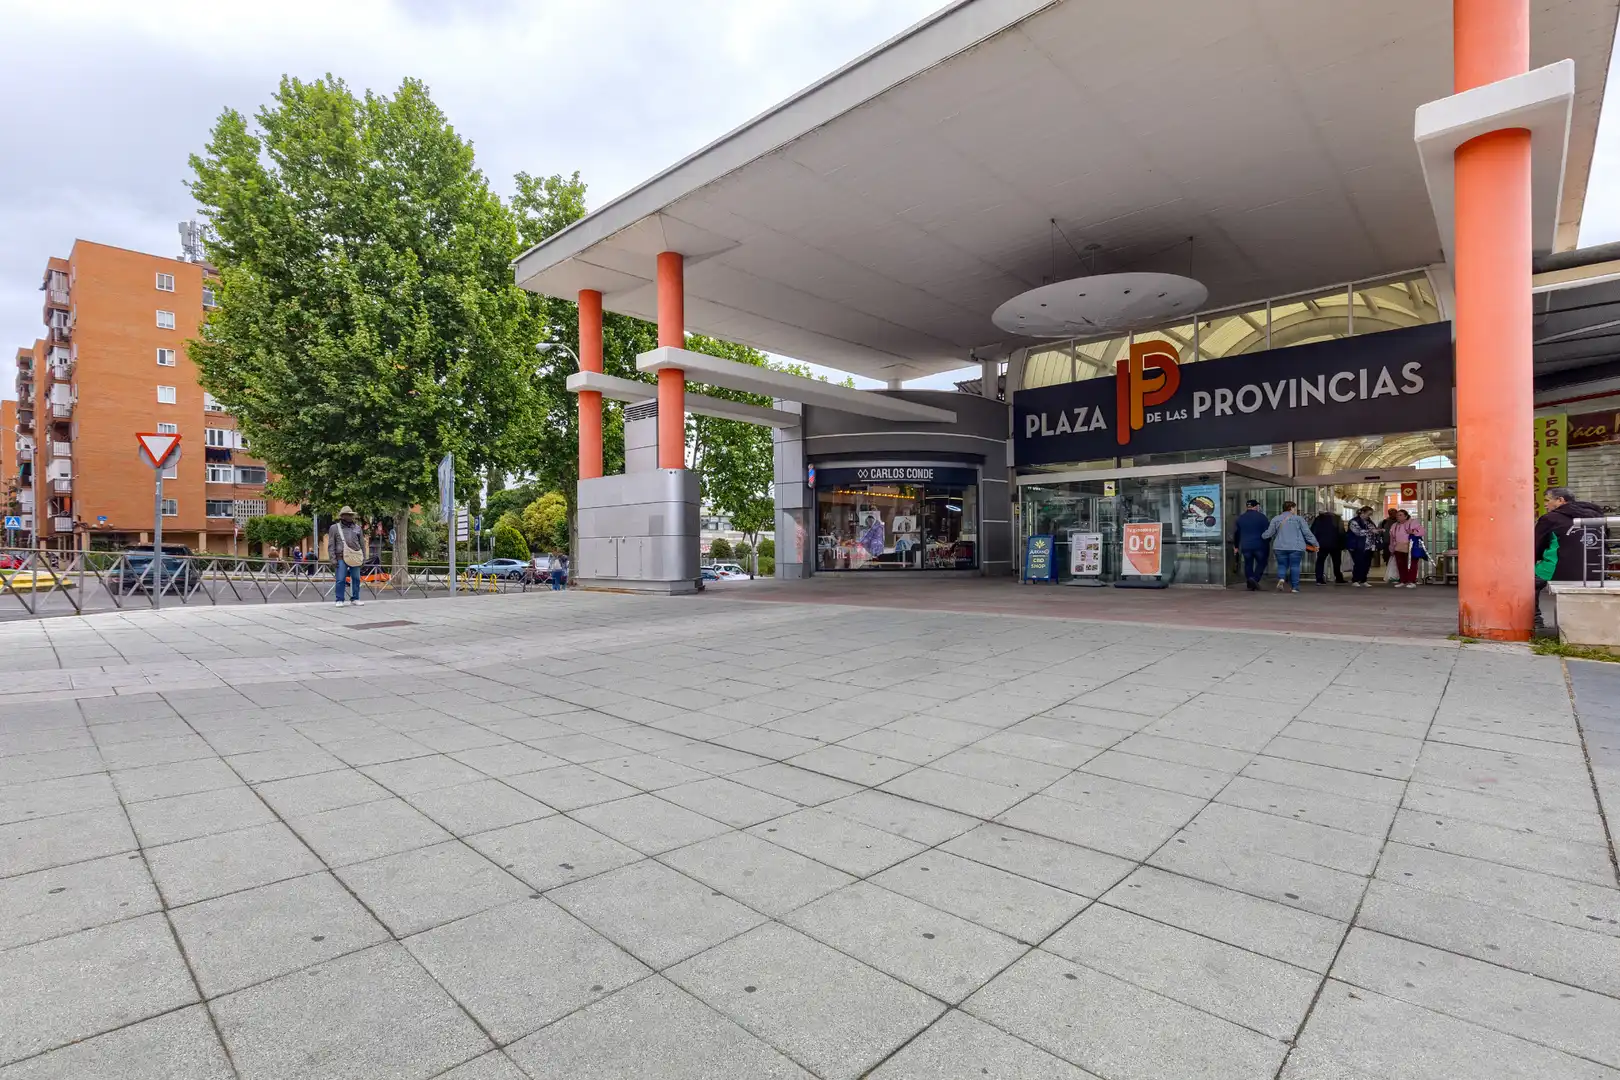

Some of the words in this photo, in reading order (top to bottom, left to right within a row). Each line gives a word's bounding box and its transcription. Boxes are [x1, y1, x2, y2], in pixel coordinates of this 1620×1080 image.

[1026, 405, 1107, 438] PLAZA
[1146, 411, 1161, 424] DE
[1166, 409, 1188, 421] LAS
[1193, 361, 1425, 419] PROVINCIAS
[870, 468, 905, 479] CARLOS
[906, 468, 934, 479] CONDE
[1545, 458, 1559, 488] CIE
